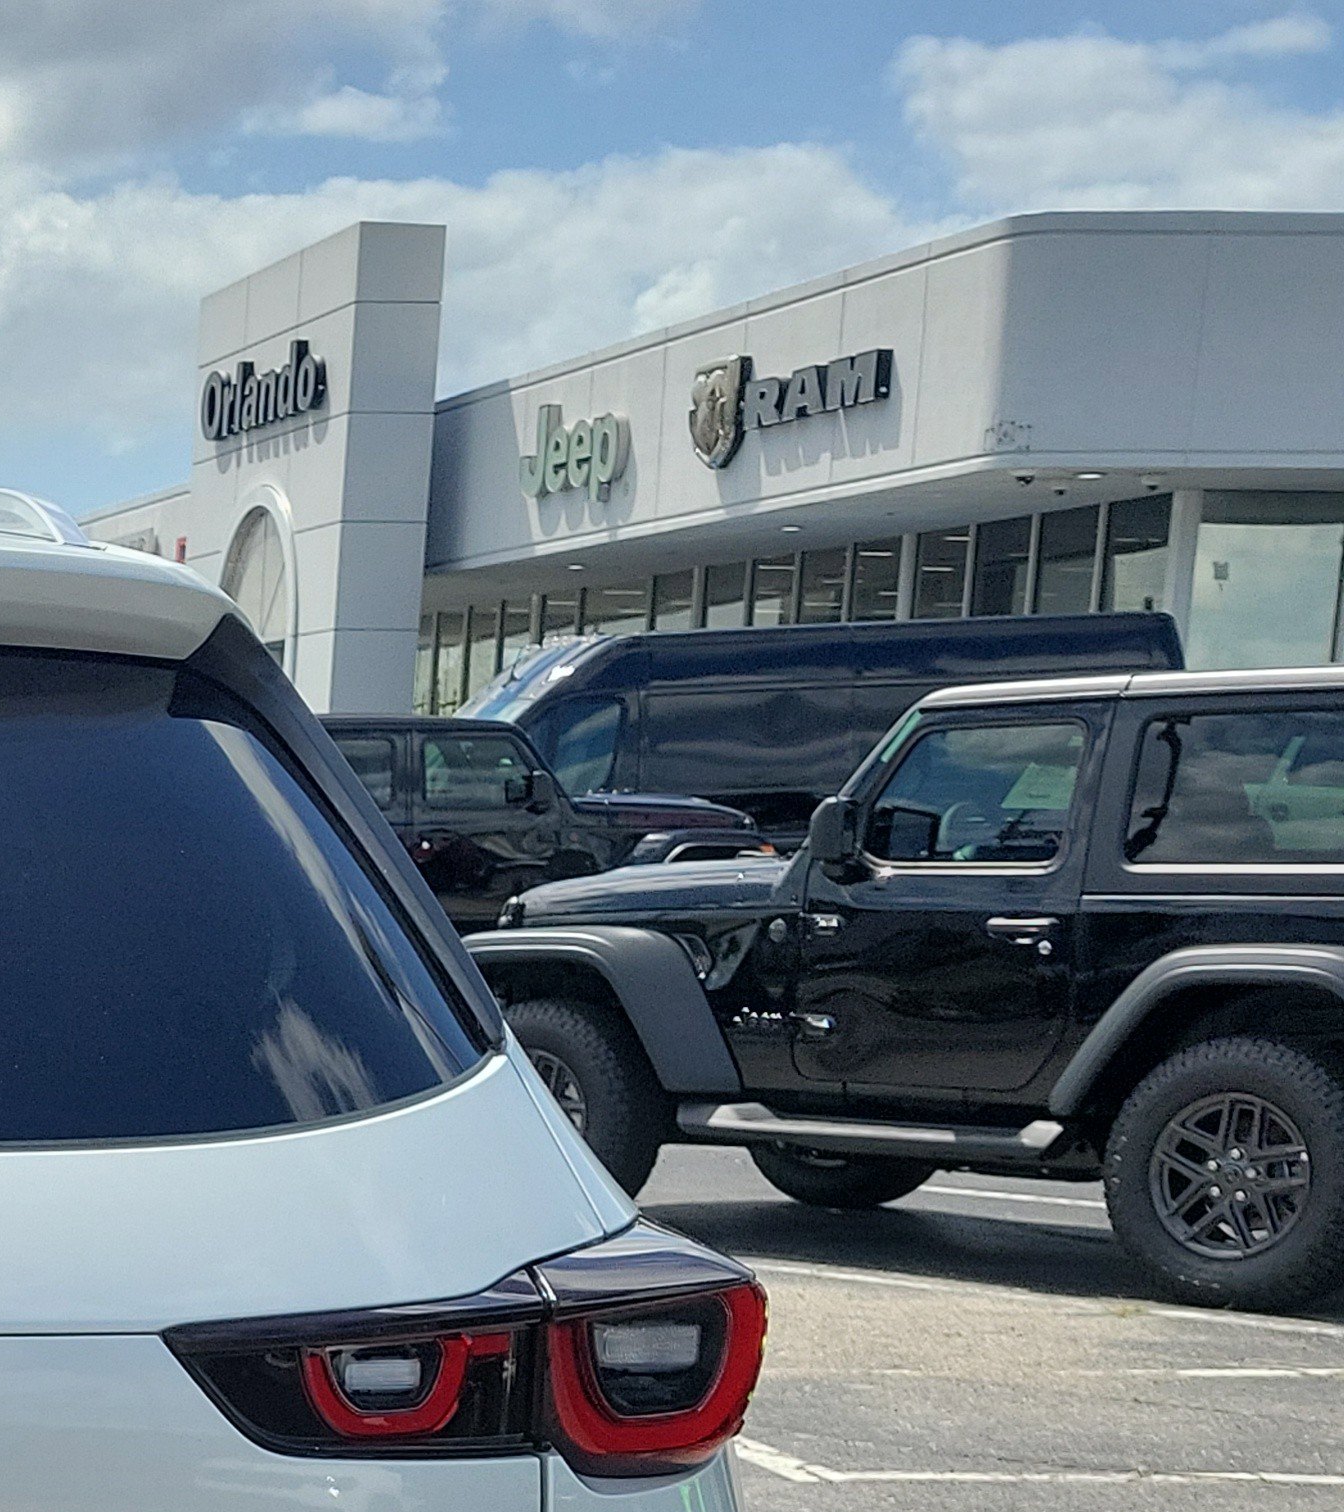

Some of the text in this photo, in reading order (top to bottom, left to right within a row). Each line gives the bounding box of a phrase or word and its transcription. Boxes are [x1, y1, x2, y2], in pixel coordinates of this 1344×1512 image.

[201, 339, 326, 441] Orlando
[743, 348, 894, 432] RAM
[519, 404, 631, 502] Jeep
